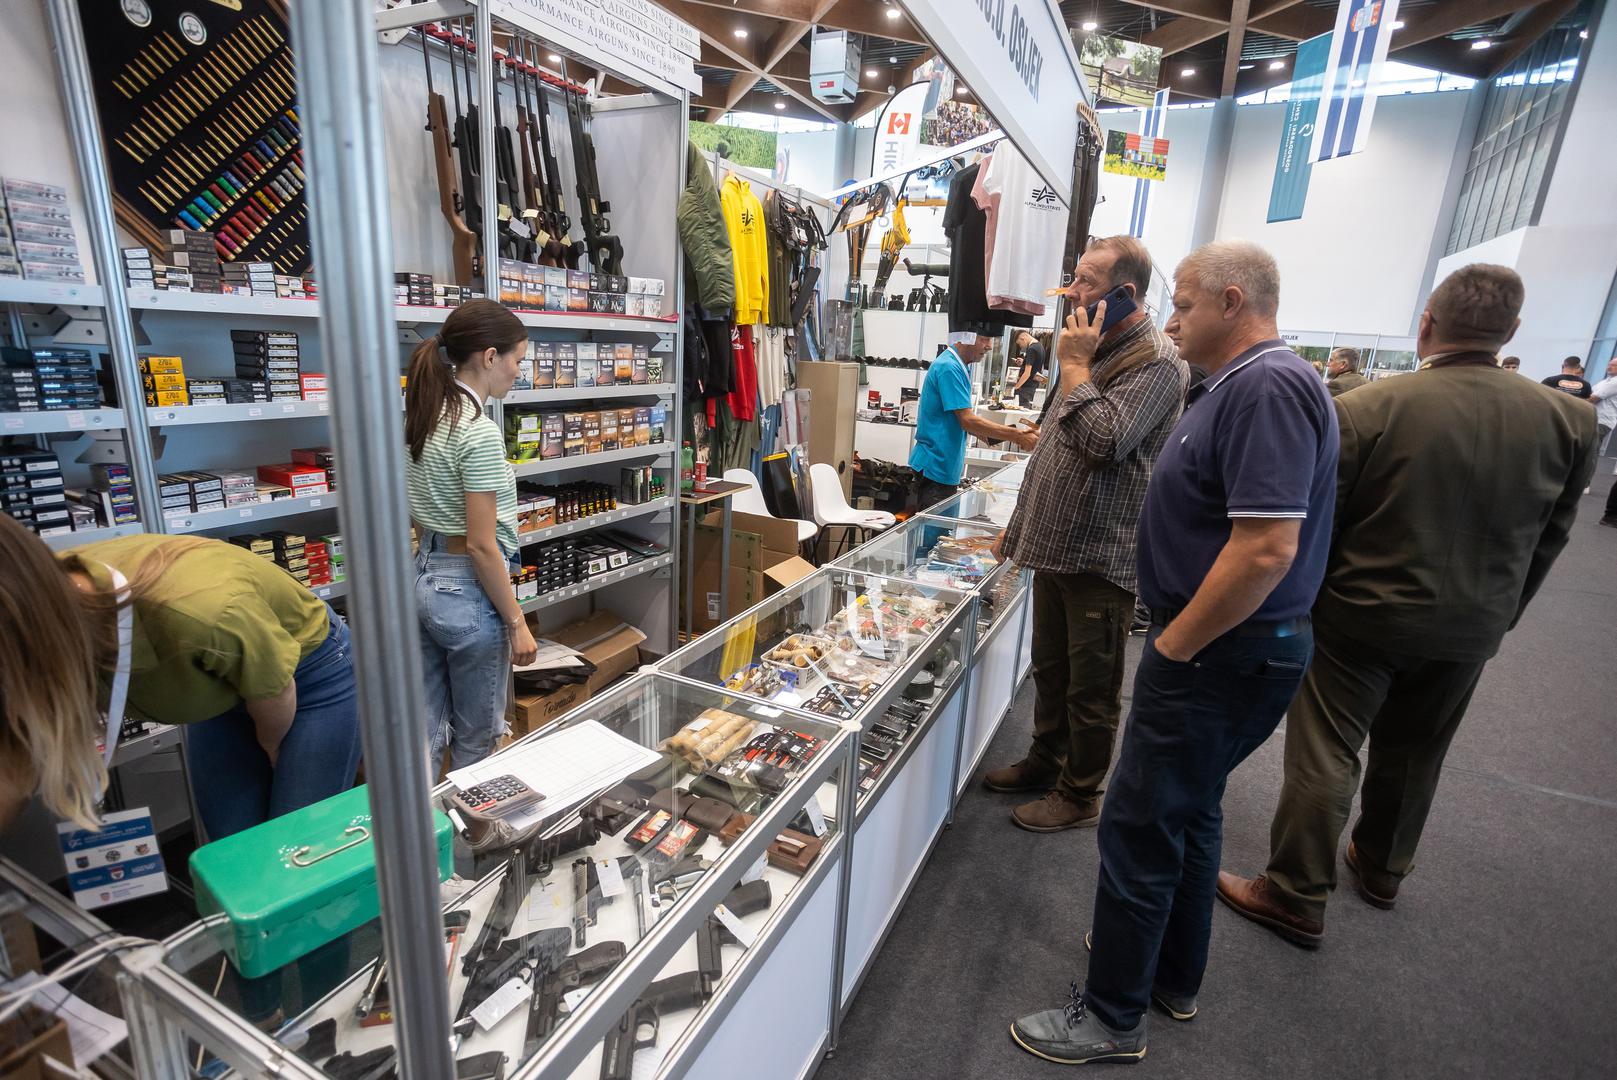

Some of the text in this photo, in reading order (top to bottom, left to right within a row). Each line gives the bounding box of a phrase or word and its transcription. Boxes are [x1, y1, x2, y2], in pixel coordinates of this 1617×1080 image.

[600, 14, 640, 40] AIRGUNS
[642, 37, 665, 57] SINCE
[668, 49, 686, 65] 1890
[608, 2, 693, 53] AIRGUNS SINCE 1890
[651, 8, 673, 28] SINCE
[676, 22, 693, 37] 1890
[587, 25, 629, 52] AIRGUNS
[632, 47, 656, 65] SINCE
[658, 60, 676, 74] 1890
[1009, 3, 1043, 104] OSIJEK
